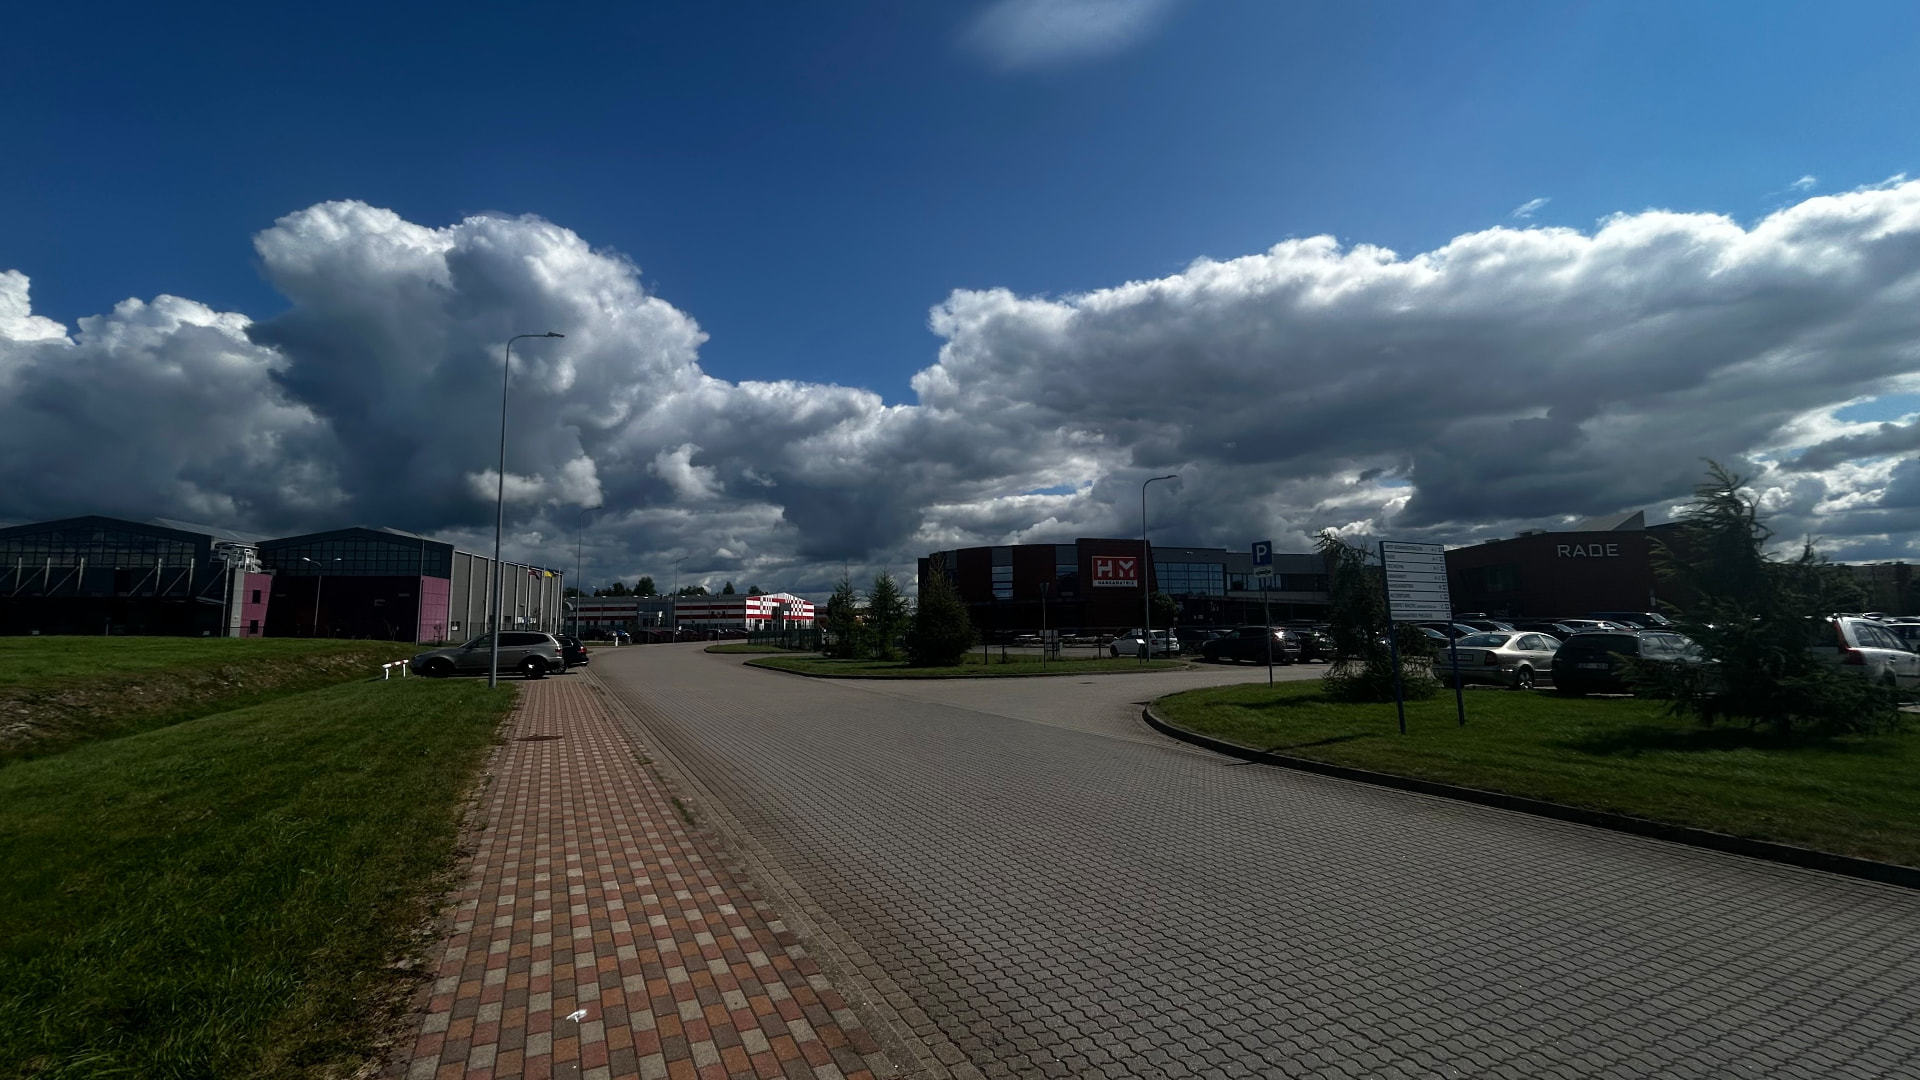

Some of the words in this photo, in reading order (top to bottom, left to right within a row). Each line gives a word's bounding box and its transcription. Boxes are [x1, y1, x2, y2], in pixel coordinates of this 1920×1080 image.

[1256, 544, 1267, 562] P
[1557, 543, 1620, 558] RADE
[1097, 559, 1134, 578] HM
